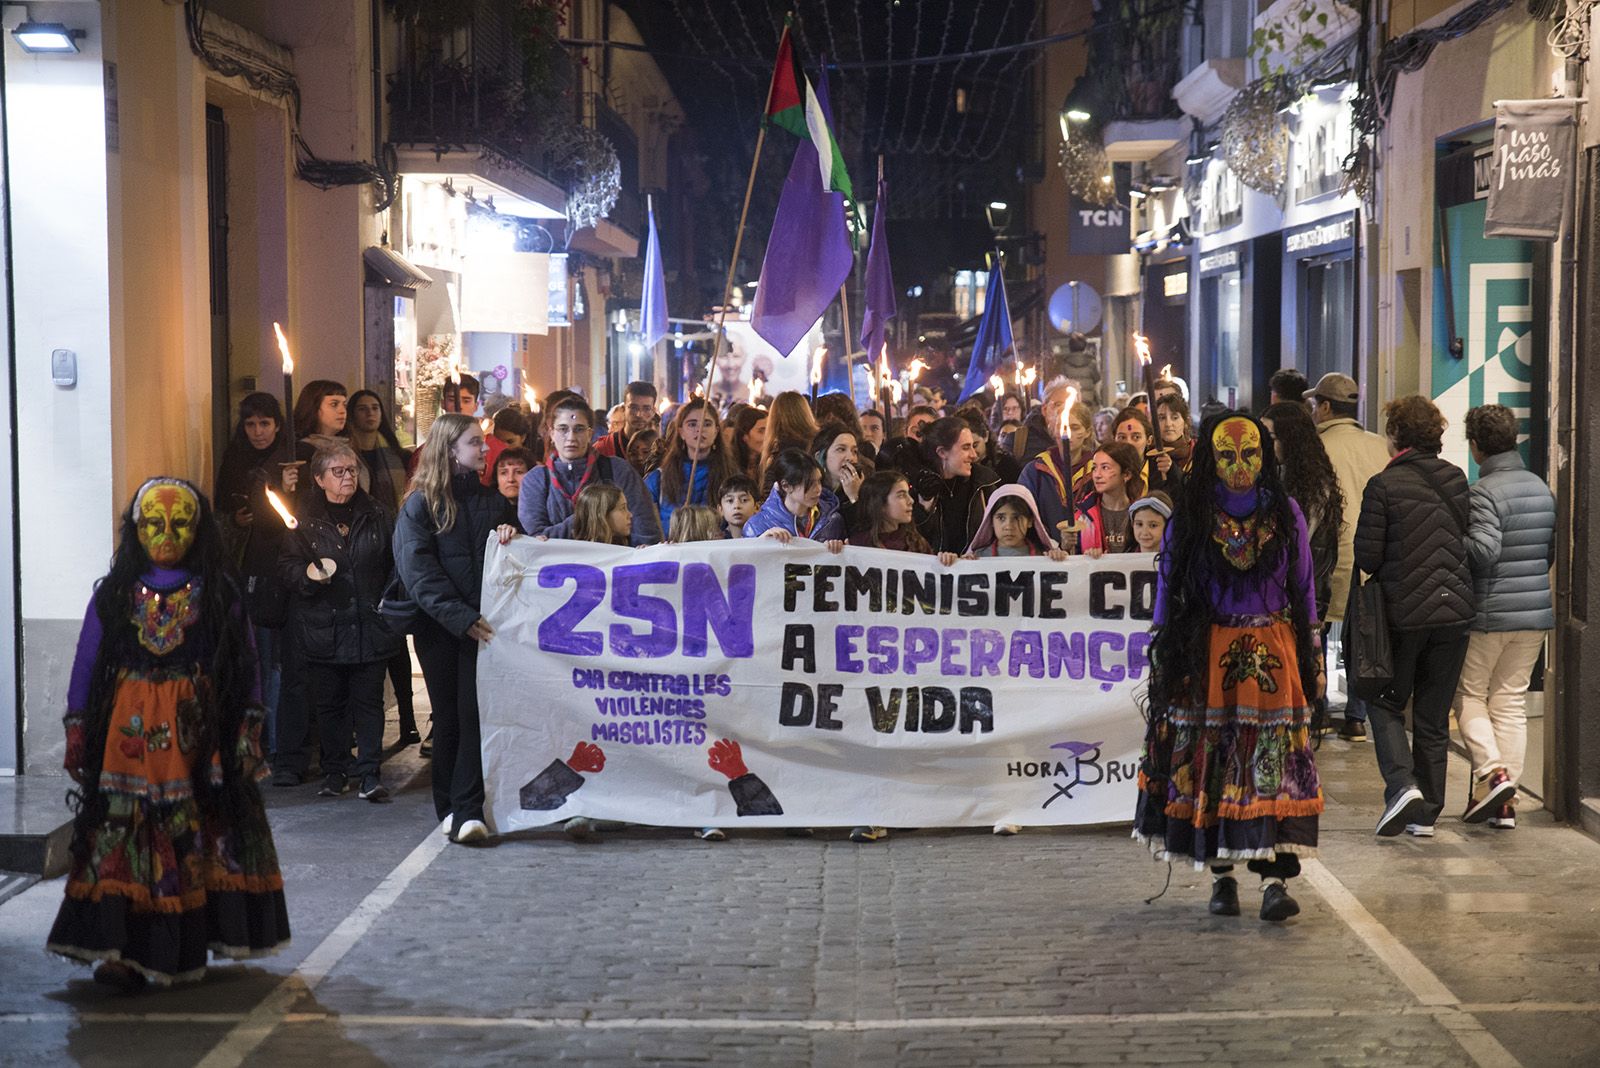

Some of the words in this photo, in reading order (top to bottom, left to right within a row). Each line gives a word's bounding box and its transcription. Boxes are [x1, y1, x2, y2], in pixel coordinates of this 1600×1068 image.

[1511, 129, 1549, 147] un
[1499, 143, 1551, 190] paso
[1079, 209, 1123, 227] TCN
[537, 560, 756, 659] 25N
[784, 563, 1069, 619] FEMINISME
[781, 623, 816, 673] A
[572, 667, 605, 691] DIA
[607, 670, 690, 696] CONTRA
[692, 673, 733, 697] LES
[779, 682, 844, 731] DE
[865, 686, 994, 734] VIDA
[591, 719, 708, 746] MASCLISTES
[1007, 761, 1070, 778] HORA
